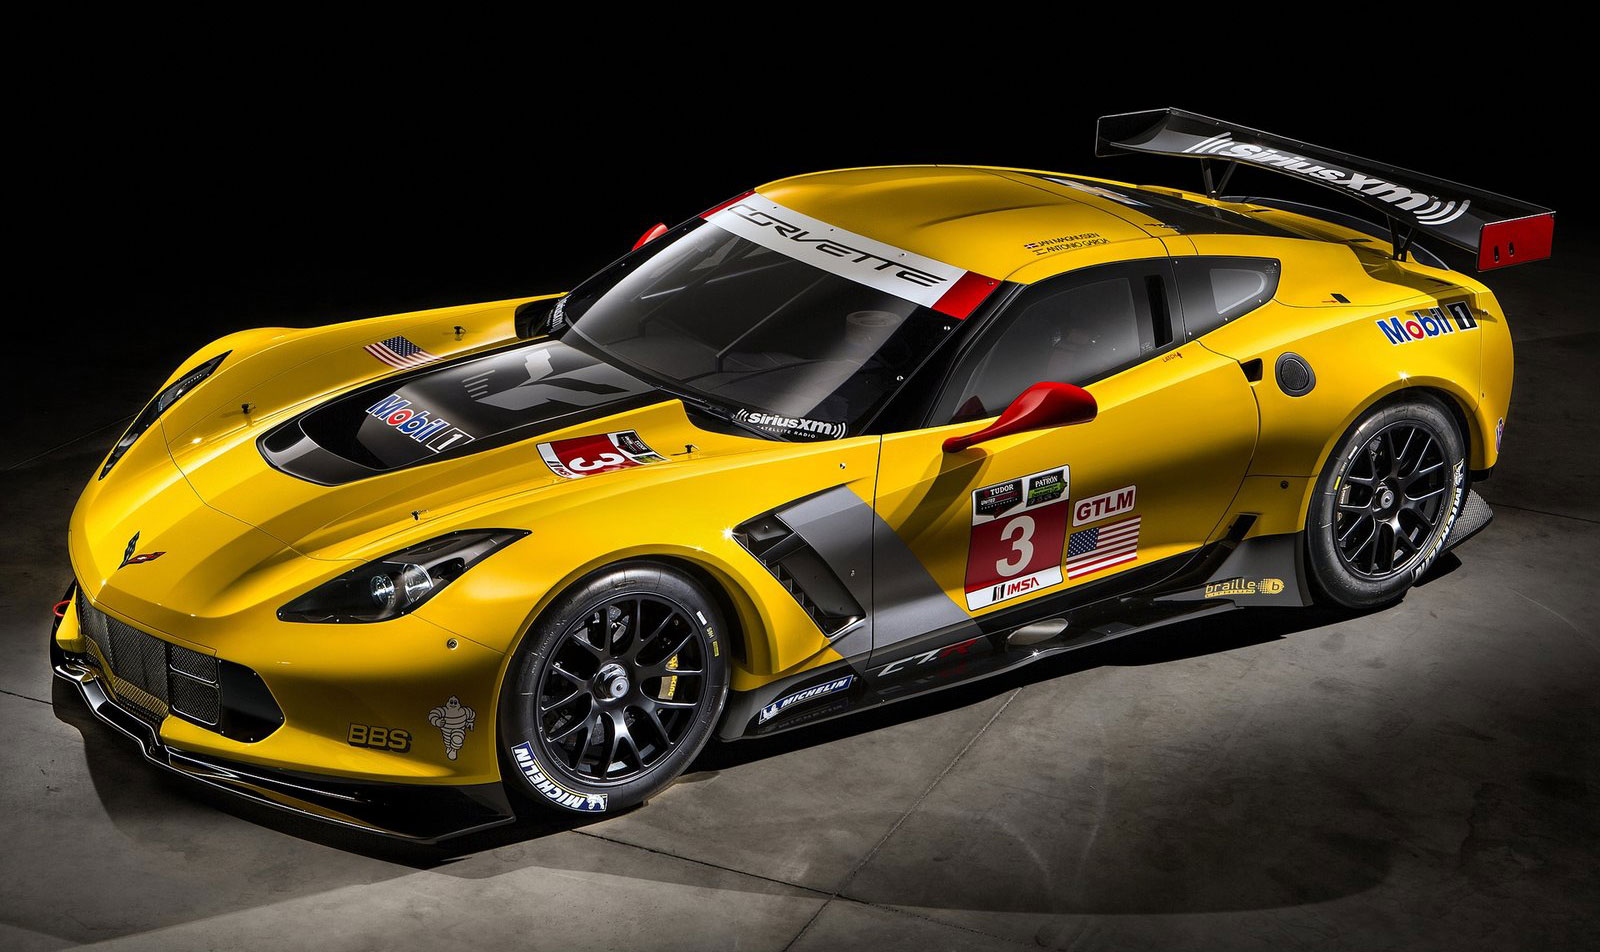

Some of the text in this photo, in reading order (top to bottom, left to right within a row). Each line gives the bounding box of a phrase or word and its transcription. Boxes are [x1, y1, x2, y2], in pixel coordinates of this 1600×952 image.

[727, 204, 948, 287] CORVETTE
[1376, 306, 1454, 346] Mobil
[365, 394, 452, 442] Mobil
[794, 430, 816, 439] RADIO
[568, 452, 626, 471] 3
[989, 484, 1014, 496] TUDOR
[1076, 490, 1134, 521] GTLM
[995, 515, 1036, 577] 3
[1007, 576, 1040, 596] IMSA
[1205, 578, 1256, 594] braille
[780, 678, 848, 710] MICHELIN
[347, 723, 413, 754] BBS
[513, 747, 586, 809] MICHELIN
